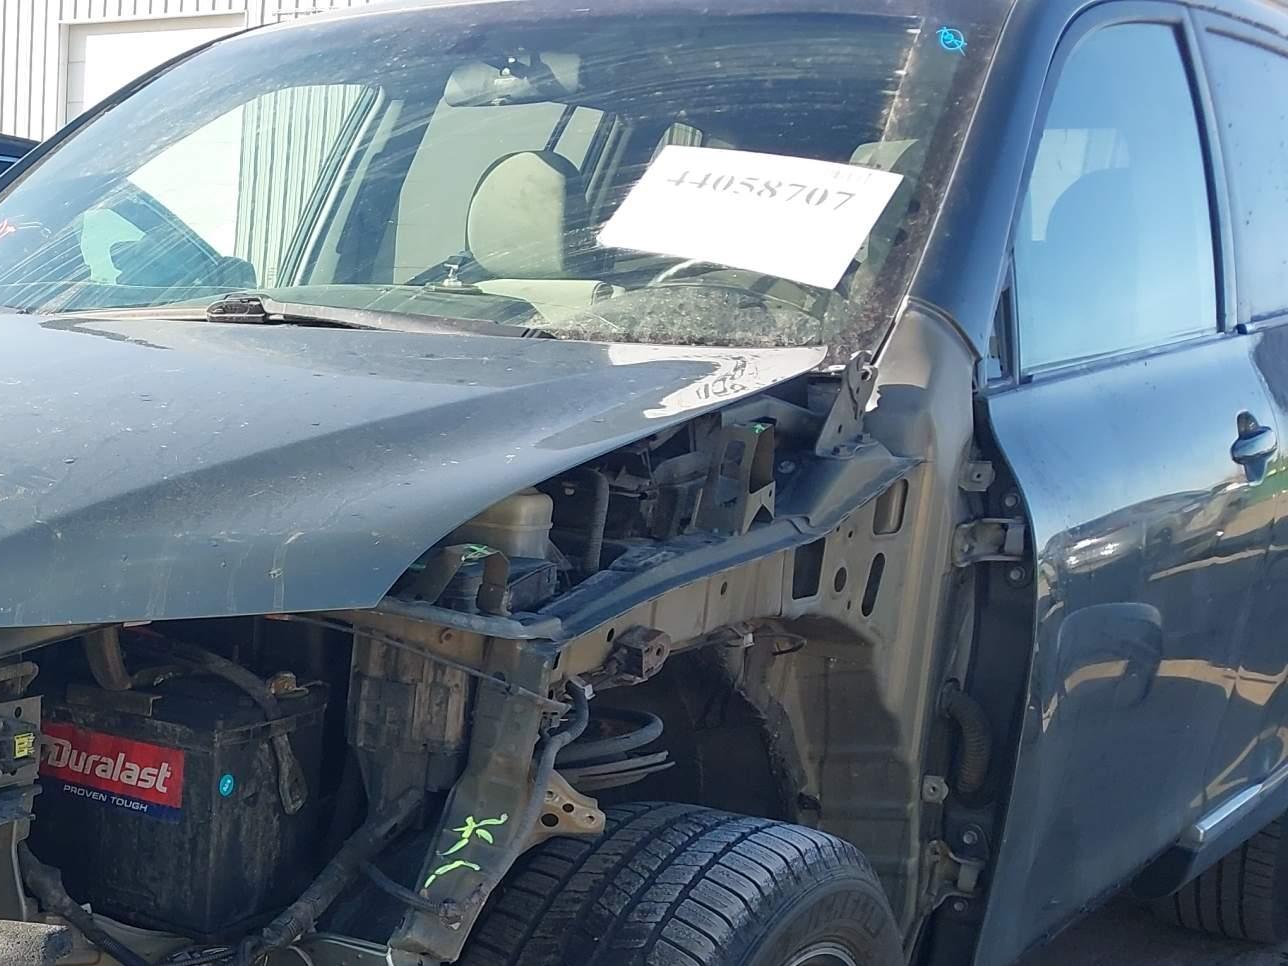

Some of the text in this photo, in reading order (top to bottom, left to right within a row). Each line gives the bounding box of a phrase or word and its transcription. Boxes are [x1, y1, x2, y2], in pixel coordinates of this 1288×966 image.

[666, 169, 857, 211] 44058707
[41, 735, 172, 793] Duralast
[63, 784, 148, 812] PROVEN TOUGH
